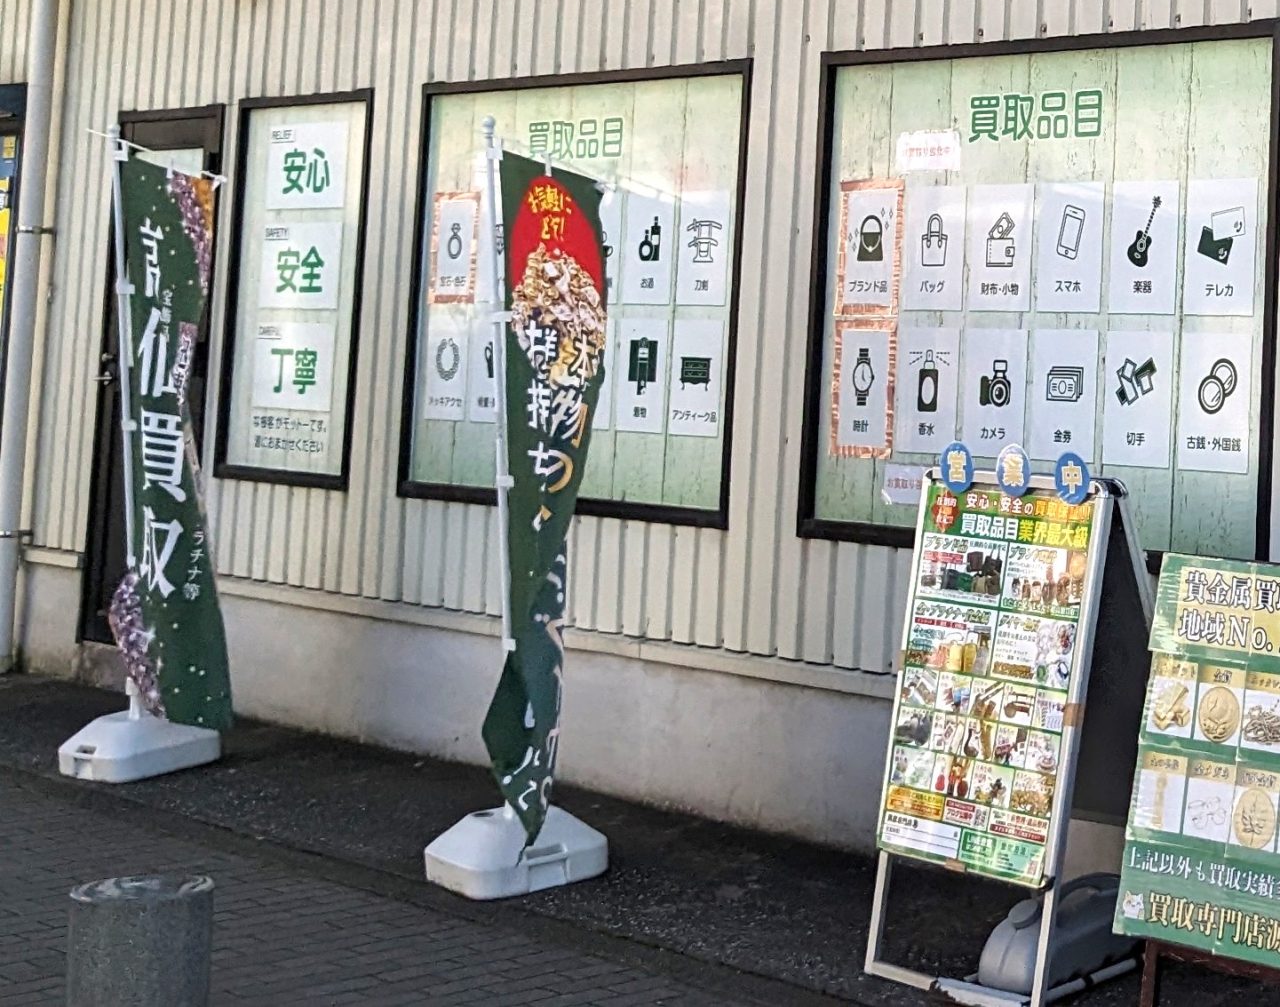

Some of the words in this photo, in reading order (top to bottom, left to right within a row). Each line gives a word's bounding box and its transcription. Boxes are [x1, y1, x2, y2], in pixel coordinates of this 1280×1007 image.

[968, 89, 1103, 143] 買取品目
[529, 117, 624, 160] 買取品目
[282, 148, 330, 195] 安心
[276, 246, 325, 293] 安全
[849, 280, 888, 293] ブランド品
[920, 280, 945, 293] バッグ
[980, 283, 1019, 296] 財布・小物
[1055, 280, 1081, 293] スマホ
[1132, 280, 1152, 294] 楽器
[1205, 283, 1234, 297] テレカ
[271, 348, 318, 395] 丁寧
[672, 409, 717, 423] アンティーク品
[852, 419, 869, 433] 時計
[918, 422, 935, 436] 香水
[980, 426, 1006, 440] カメラ
[1053, 429, 1072, 444] 金券
[1126, 431, 1145, 446] 切手
[1186, 435, 1242, 452] 古銭・外国銭
[961, 513, 1088, 549] 買取品目業界最大級
